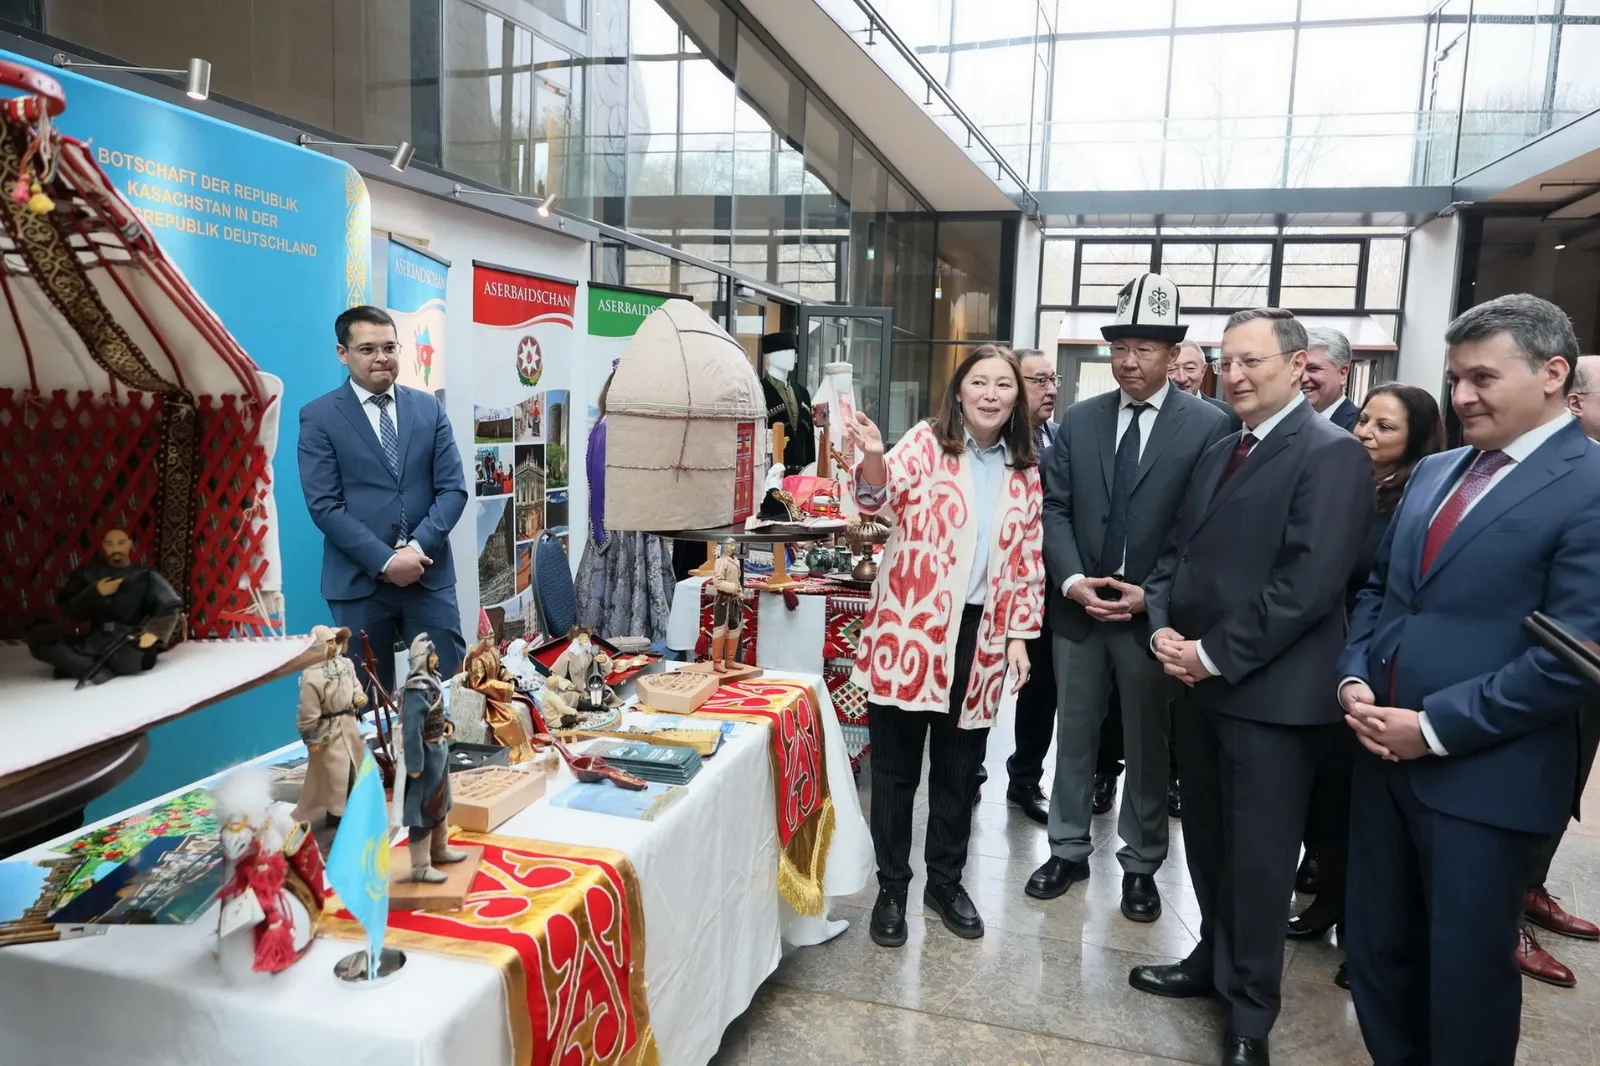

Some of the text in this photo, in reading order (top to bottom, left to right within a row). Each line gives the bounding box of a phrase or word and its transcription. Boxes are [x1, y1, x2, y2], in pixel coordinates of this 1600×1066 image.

[97, 147, 299, 212] BOTSCHAFT DER REPUBLIK
[127, 180, 279, 228] KASACHSTAN IN DER
[223, 226, 318, 257] DEUTSCHLAND
[394, 257, 447, 290] ASERBAIDSCHAN
[483, 280, 571, 308] ASERBAIDSCHAN
